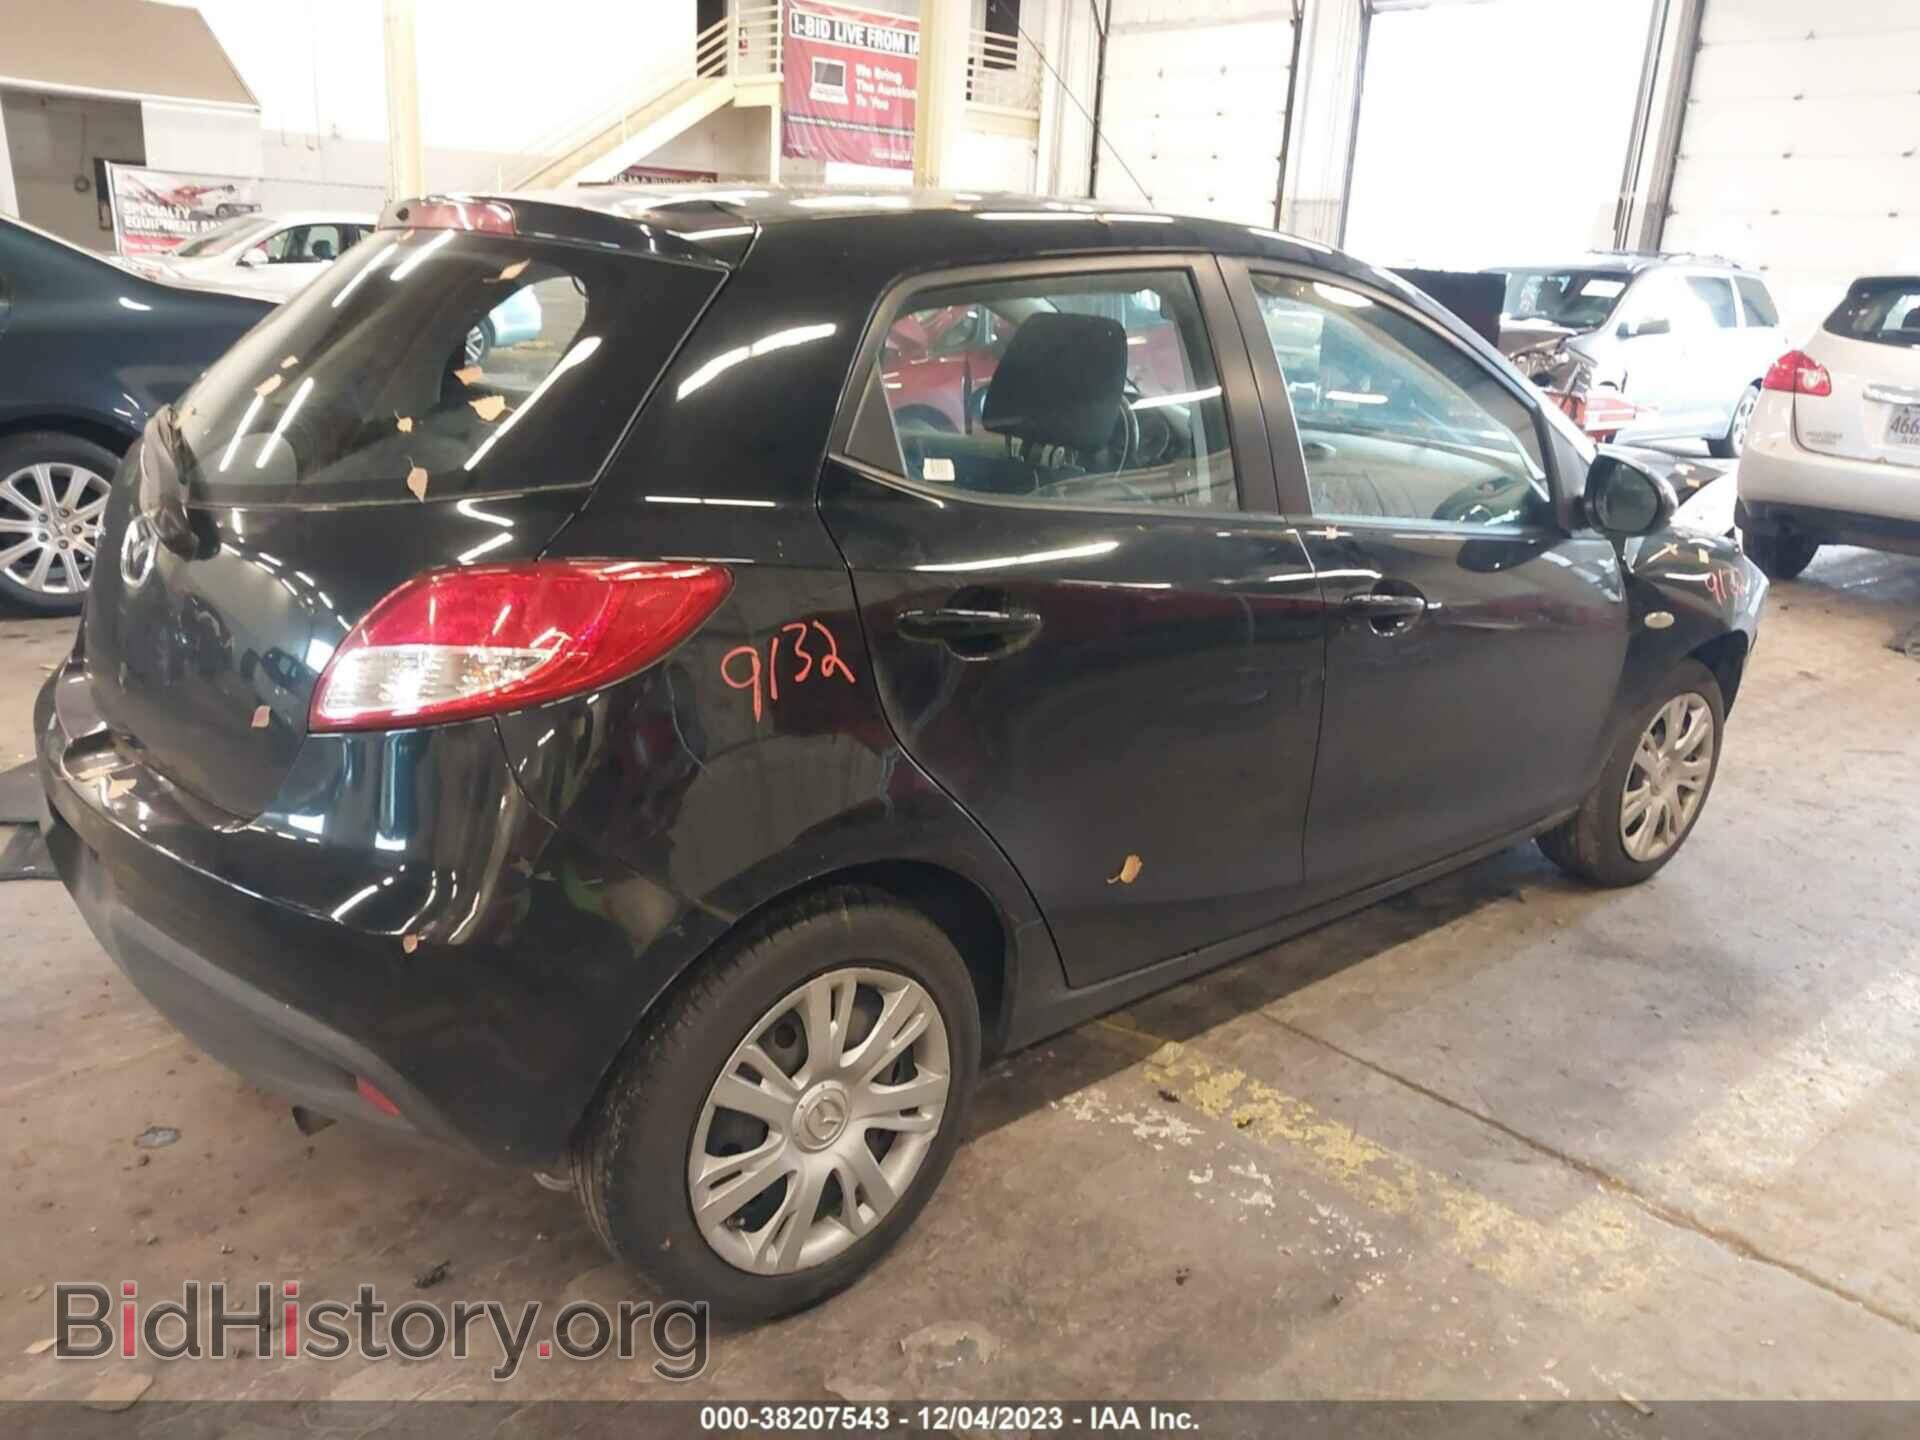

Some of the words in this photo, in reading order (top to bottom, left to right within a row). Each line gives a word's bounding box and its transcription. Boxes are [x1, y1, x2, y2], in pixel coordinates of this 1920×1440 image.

[834, 21, 865, 46] LIVE
[867, 26, 906, 54] FROM
[874, 67, 903, 85] Bring
[856, 79, 874, 93] The
[877, 83, 918, 99] Auction
[856, 93, 867, 108] To
[870, 95, 889, 111] You
[123, 200, 191, 219] SPECIALTY
[125, 215, 198, 233] EQUIPMENT
[721, 620, 855, 722] 9132
